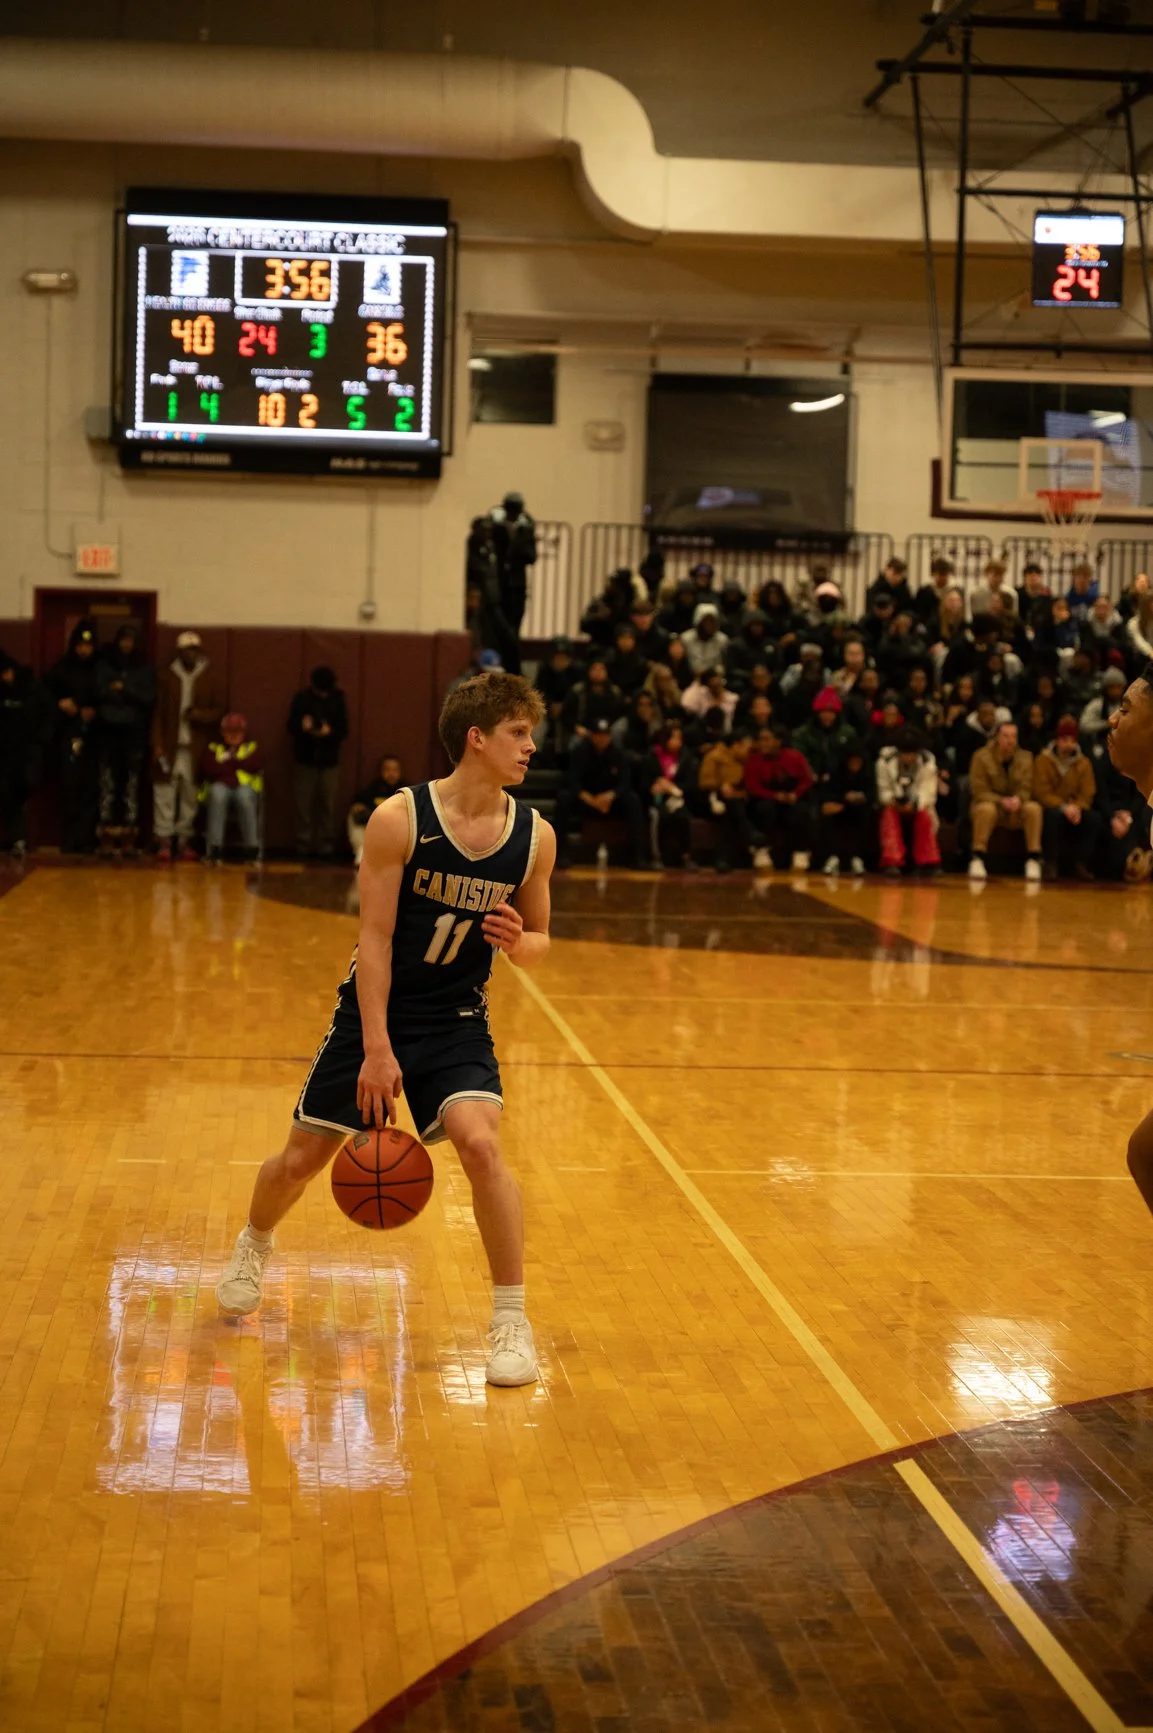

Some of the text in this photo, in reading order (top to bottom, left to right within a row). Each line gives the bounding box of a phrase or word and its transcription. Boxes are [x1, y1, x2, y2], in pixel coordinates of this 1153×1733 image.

[265, 259, 331, 301] 3:56
[1052, 264, 1101, 301] 24
[171, 315, 215, 355] 40
[238, 321, 277, 357] 24
[309, 323, 327, 359] 3
[366, 322, 408, 365] 36
[168, 391, 177, 422] 1
[200, 391, 219, 422] 4
[258, 392, 286, 427] 10
[299, 393, 319, 428] 2
[346, 396, 366, 430] 5
[394, 396, 415, 431] 2
[82, 547, 110, 568] EXIT
[423, 912, 474, 966] 11
